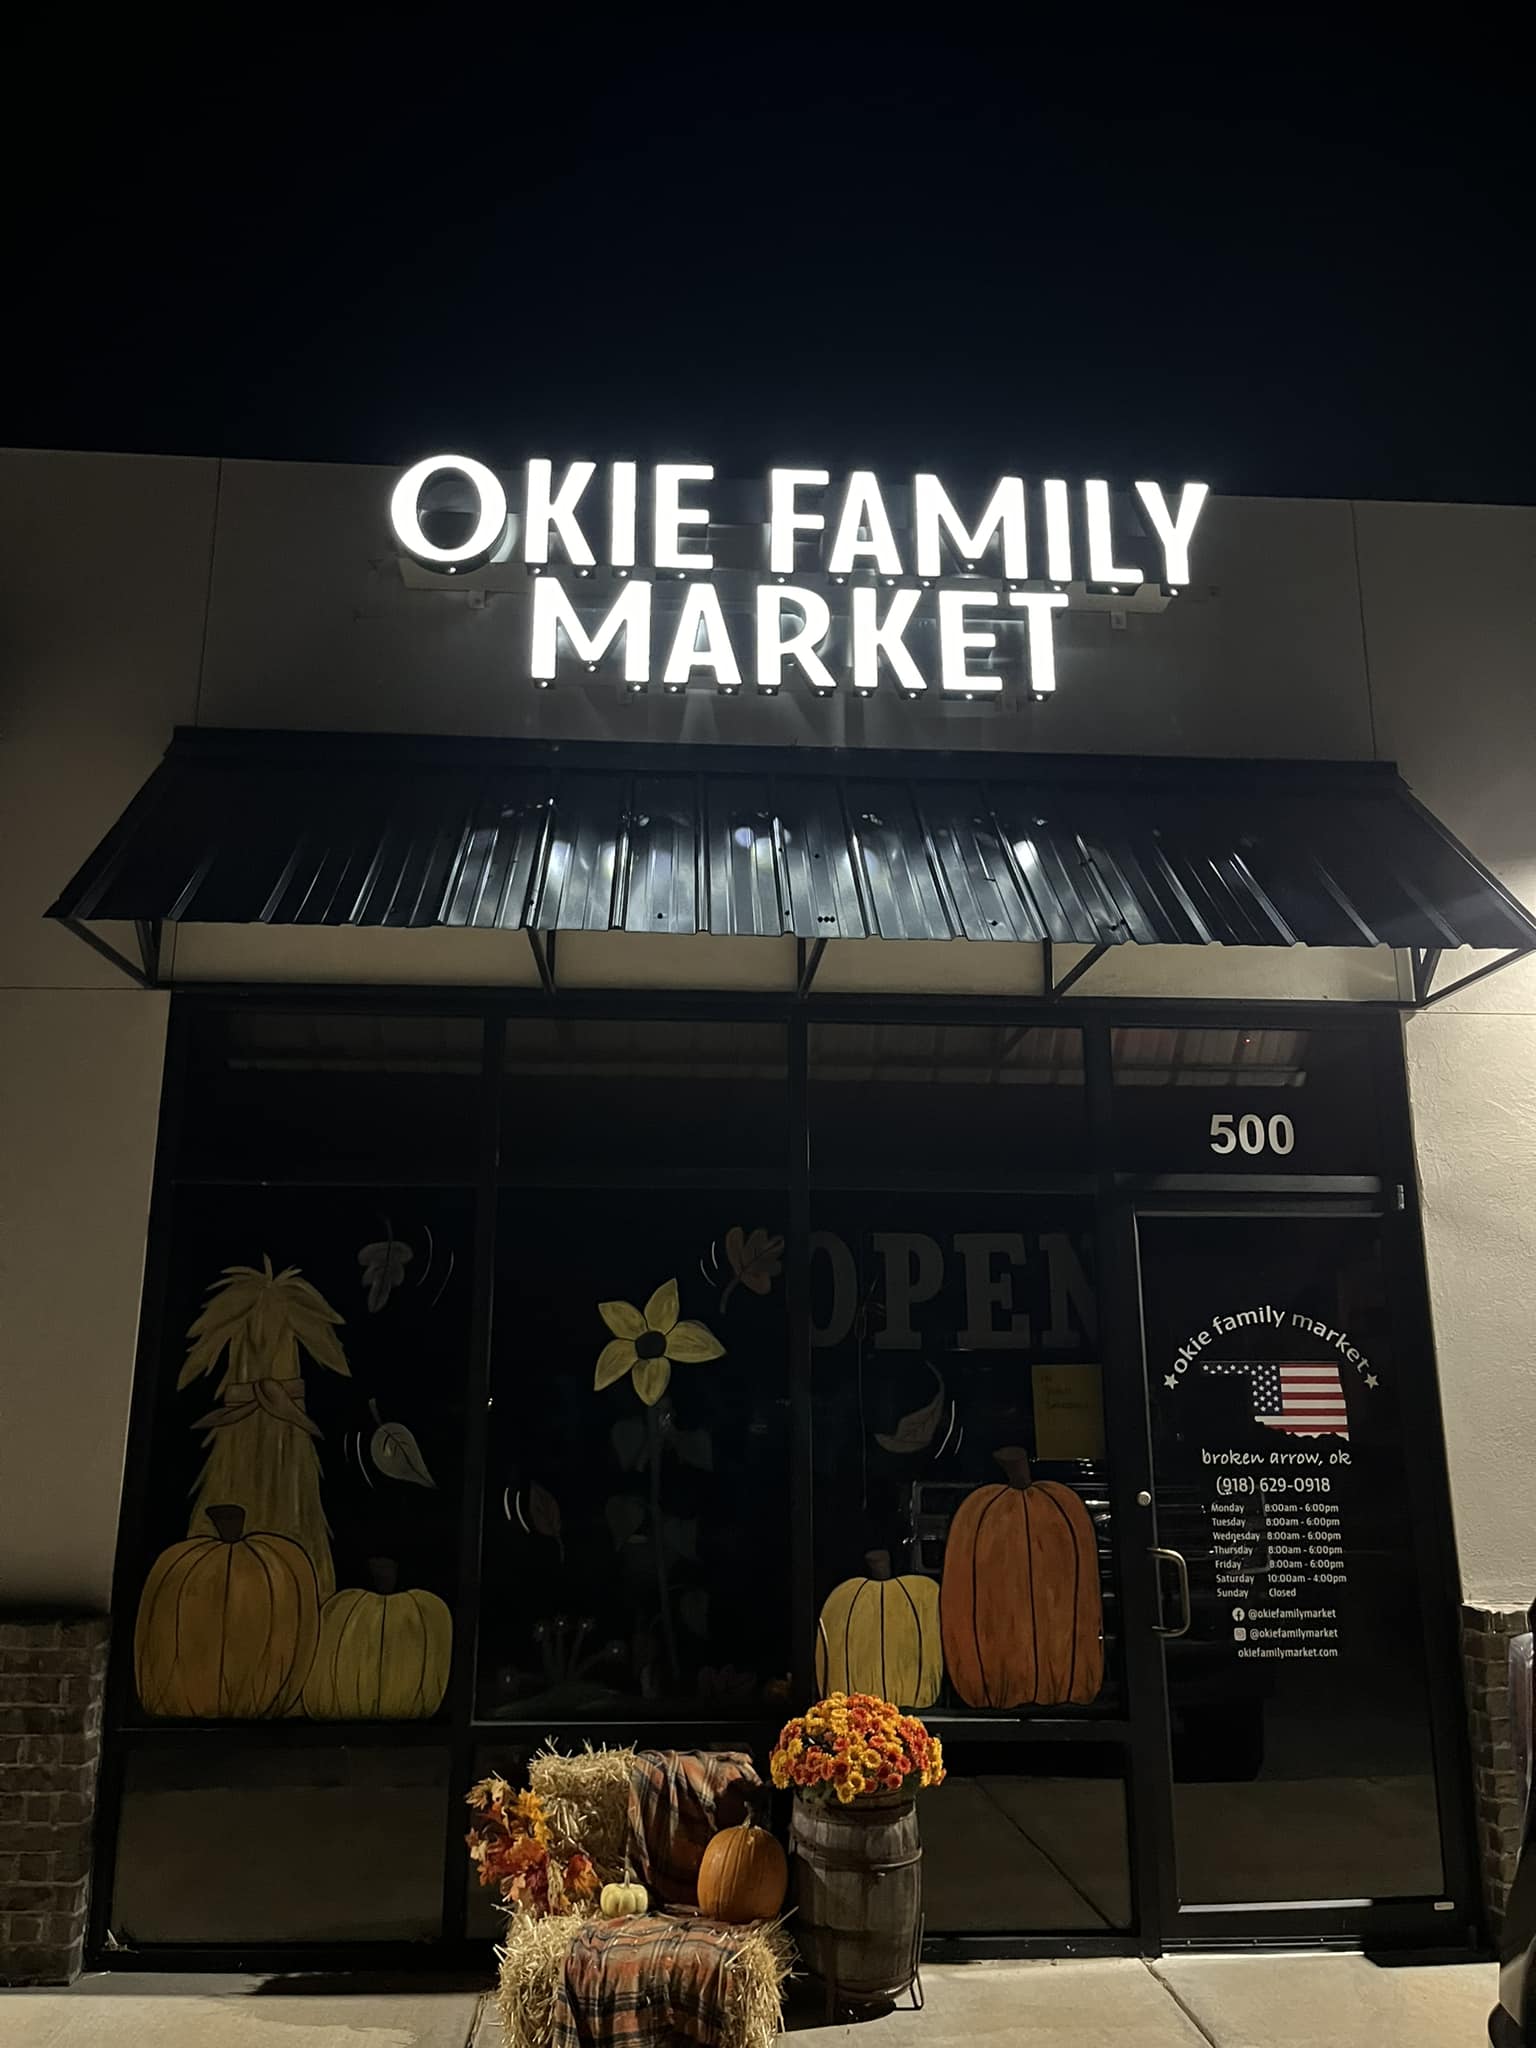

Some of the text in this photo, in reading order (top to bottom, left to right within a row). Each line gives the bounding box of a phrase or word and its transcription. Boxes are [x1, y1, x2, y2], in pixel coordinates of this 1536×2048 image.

[391, 455, 1209, 587] OKIE FAMILY
[530, 576, 1069, 694] MARKET
[1210, 1113, 1295, 1155] 500
[809, 1231, 1097, 1350] OPEN
[1173, 1305, 1370, 1375] okie family market
[1201, 1448, 1352, 1466] broken arrow, ok
[1216, 1476, 1330, 1495] (918) 629-0918
[1211, 1503, 1244, 1513] Monday
[1212, 1518, 1246, 1528] Tuesday
[1213, 1532, 1260, 1542] Wednesday
[1214, 1546, 1253, 1556] Thursday
[1215, 1560, 1242, 1570] Friday
[1216, 1574, 1254, 1584] Saturday
[1217, 1588, 1296, 1598] Sunday Closed
[1248, 1608, 1336, 1620] @okiefamilymarket
[1250, 1628, 1338, 1640] @okiefamilymarket
[1238, 1648, 1338, 1659] okiefamilymarket.com
